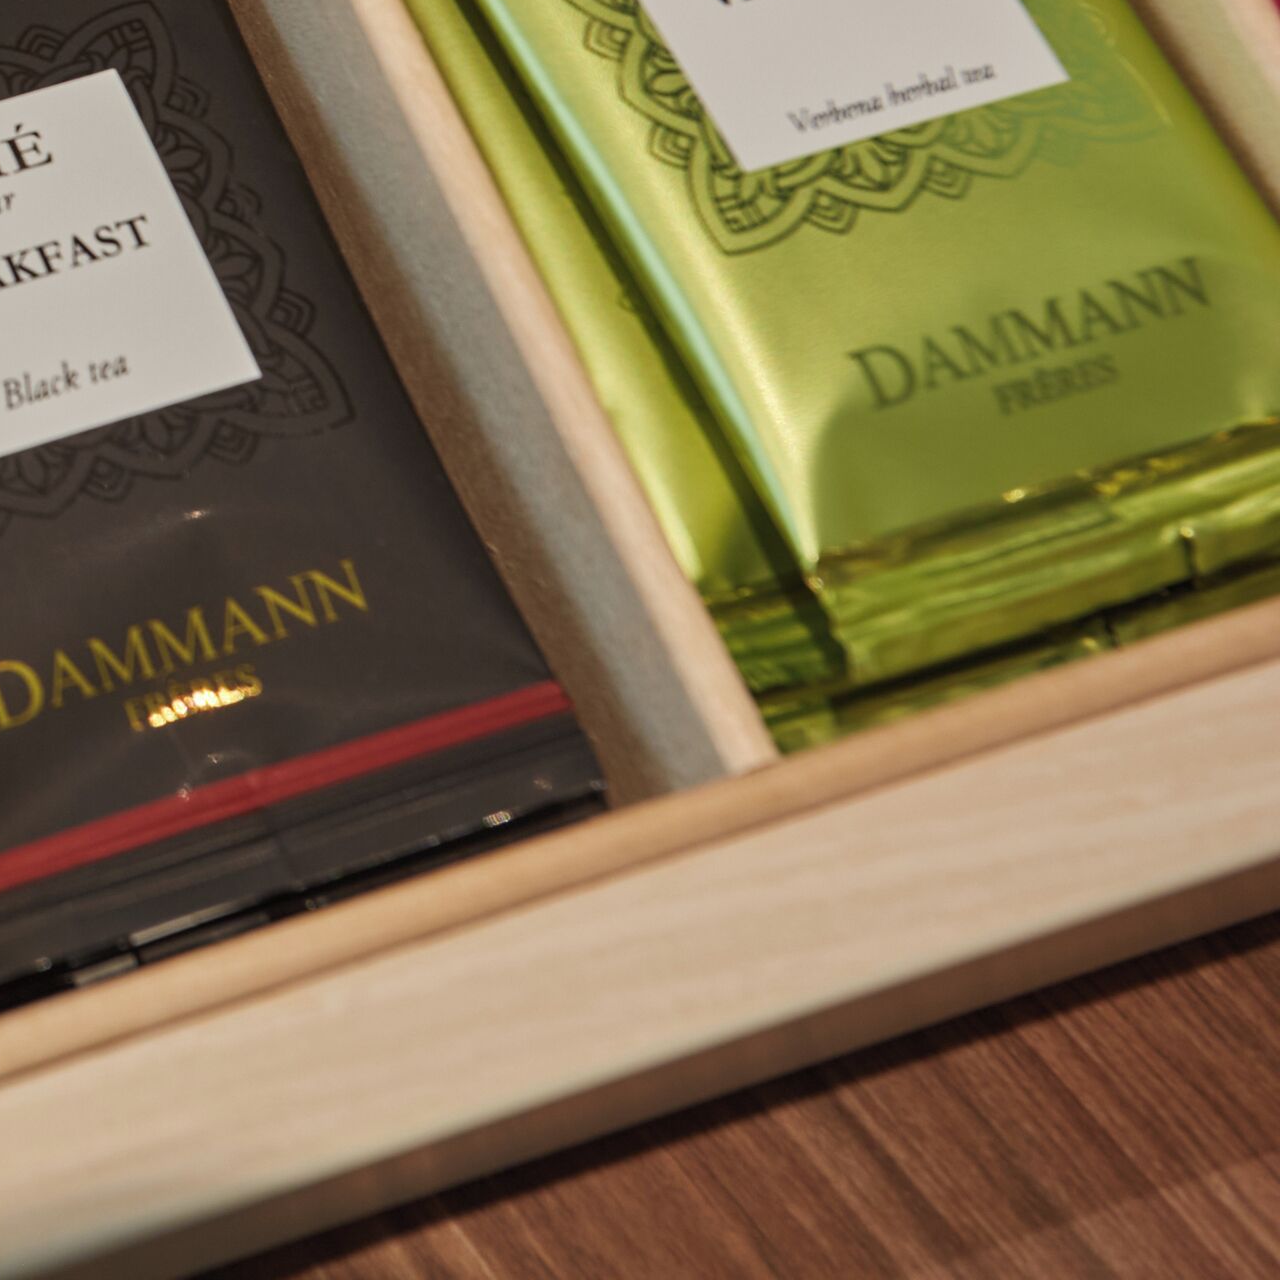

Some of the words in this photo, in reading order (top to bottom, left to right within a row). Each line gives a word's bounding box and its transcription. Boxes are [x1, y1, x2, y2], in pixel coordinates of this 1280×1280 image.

[2, 360, 81, 411] Black
[87, 355, 130, 385] tea
[848, 256, 1210, 411] DAMMANN
